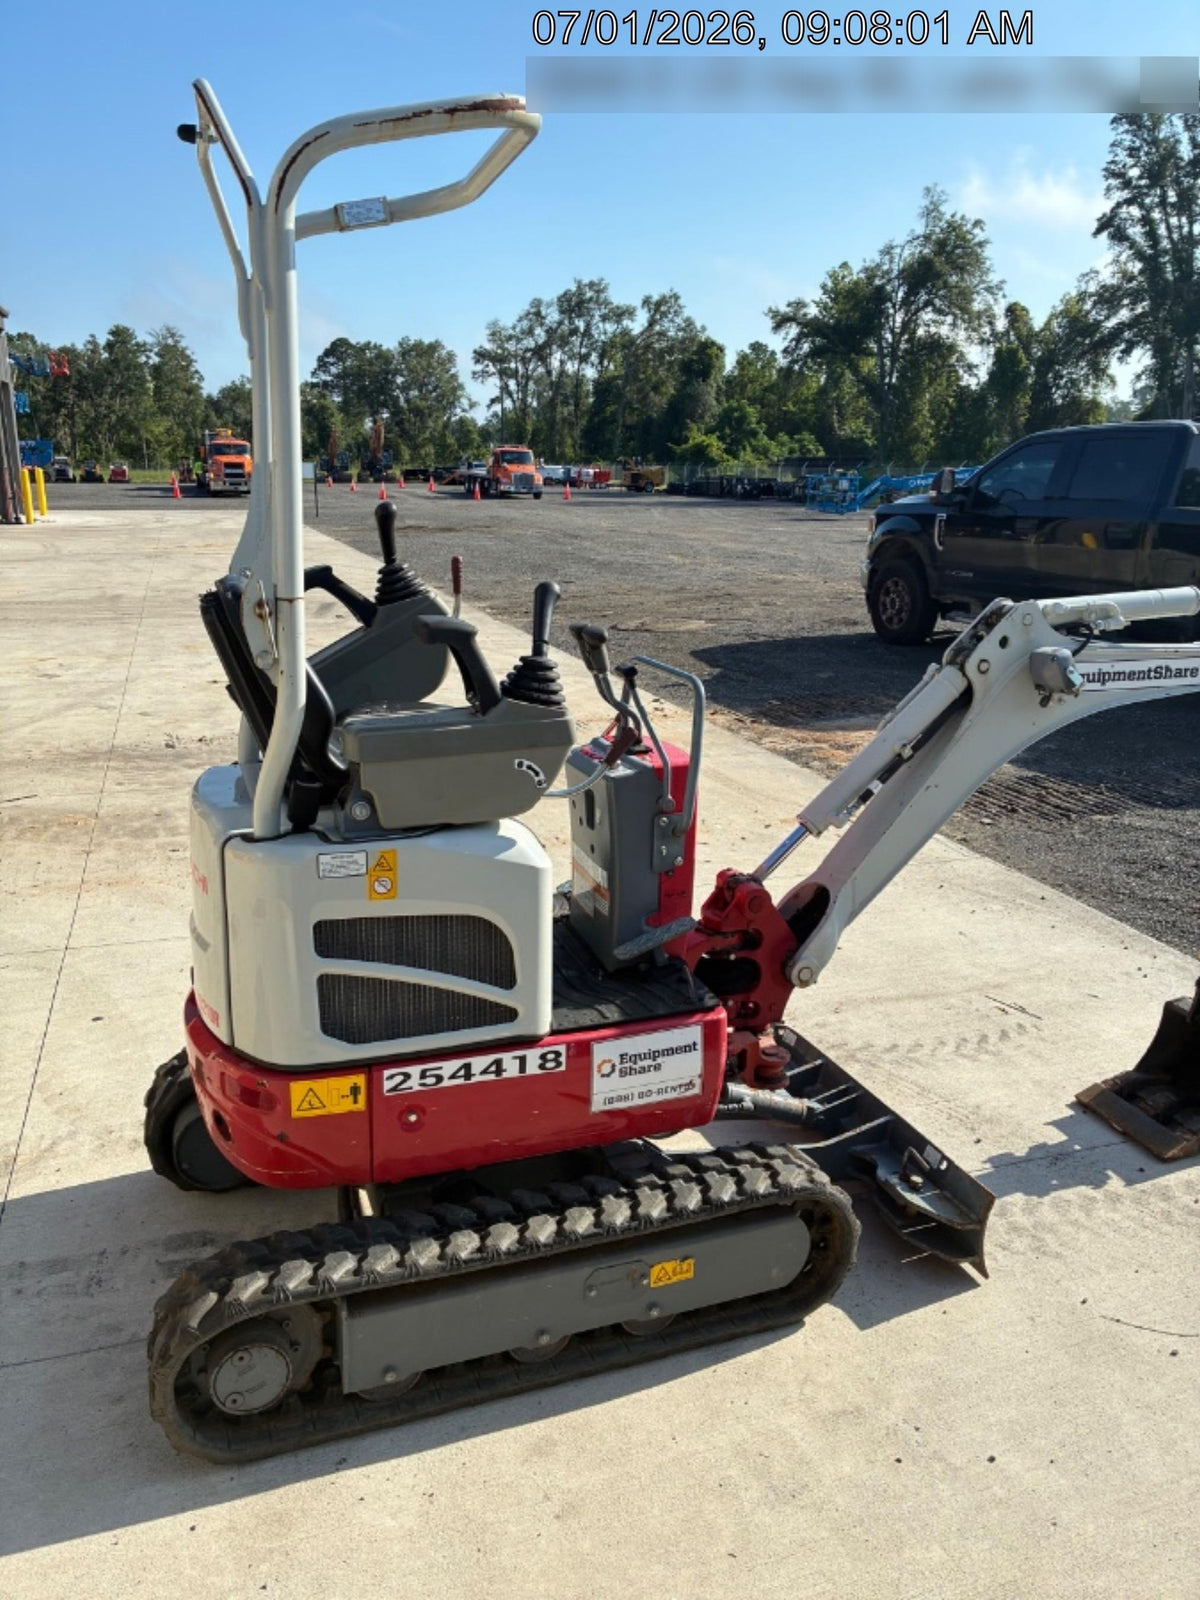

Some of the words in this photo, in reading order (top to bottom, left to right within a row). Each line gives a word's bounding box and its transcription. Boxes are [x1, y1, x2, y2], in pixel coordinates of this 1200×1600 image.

[1080, 665, 1200, 686] uipmentShare
[618, 1040, 699, 1066] Equipment
[384, 1049, 564, 1095] 254418
[618, 1062, 662, 1079] Share
